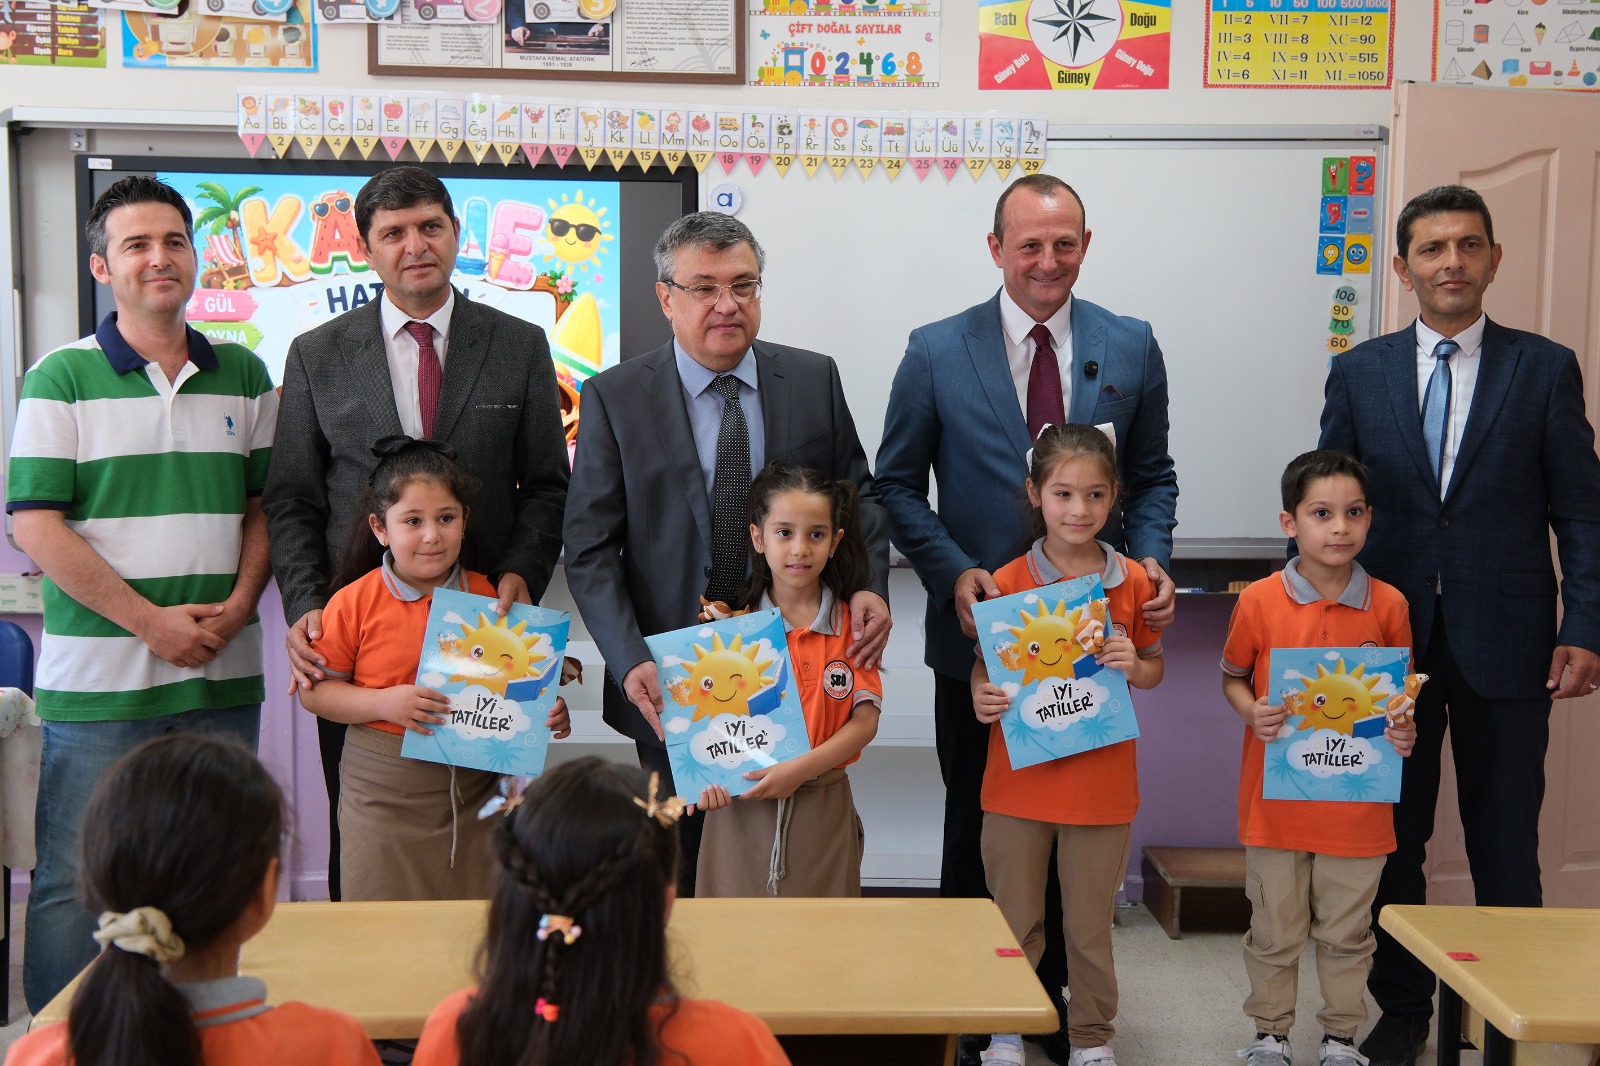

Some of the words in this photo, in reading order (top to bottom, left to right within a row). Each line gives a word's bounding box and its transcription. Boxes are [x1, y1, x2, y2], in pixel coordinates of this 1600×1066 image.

[994, 12, 1016, 26] Batı
[1130, 12, 1156, 28] Doğu
[788, 22, 813, 37] ÇİFT
[818, 22, 851, 34] DOĞAL
[856, 24, 902, 34] SAYILAR
[811, 52, 826, 75] 0
[836, 52, 850, 75] 2
[859, 52, 874, 75] 4
[882, 52, 896, 75] 6
[906, 52, 922, 75] 8
[994, 64, 1016, 84] Güney
[1013, 53, 1030, 69] Batı
[1114, 49, 1136, 68] Güney
[1136, 60, 1154, 77] Doğu
[1058, 70, 1090, 86] Güney
[250, 137, 254, 145] 1
[278, 137, 284, 146] 2
[306, 138, 312, 147] 3
[334, 138, 341, 147] 4
[363, 138, 369, 147] 5
[390, 139, 397, 148] 6
[419, 141, 425, 150] 7
[447, 141, 453, 150] 8
[475, 143, 481, 152] 9
[500, 145, 512, 154] 10
[530, 146, 538, 155] 11
[556, 147, 567, 156] 12
[585, 149, 596, 158] 13
[612, 150, 623, 159] 14
[640, 152, 651, 160] 15
[668, 153, 678, 162] 16
[695, 154, 706, 162] 17
[722, 154, 734, 164] 18
[750, 155, 761, 165] 19
[776, 156, 790, 166] 20
[806, 157, 818, 167] 21
[832, 158, 847, 168] 22
[860, 159, 873, 168] 23
[886, 160, 901, 169] 24
[916, 160, 930, 169] 25
[943, 160, 957, 169] 26
[970, 160, 984, 169] 27
[997, 160, 1012, 169] 28
[1025, 161, 1039, 170] 29
[204, 293, 236, 313] GÜL
[1335, 288, 1355, 302] 100
[1333, 305, 1348, 315] 90
[1333, 318, 1349, 329] 70
[1330, 337, 1347, 348] 60
